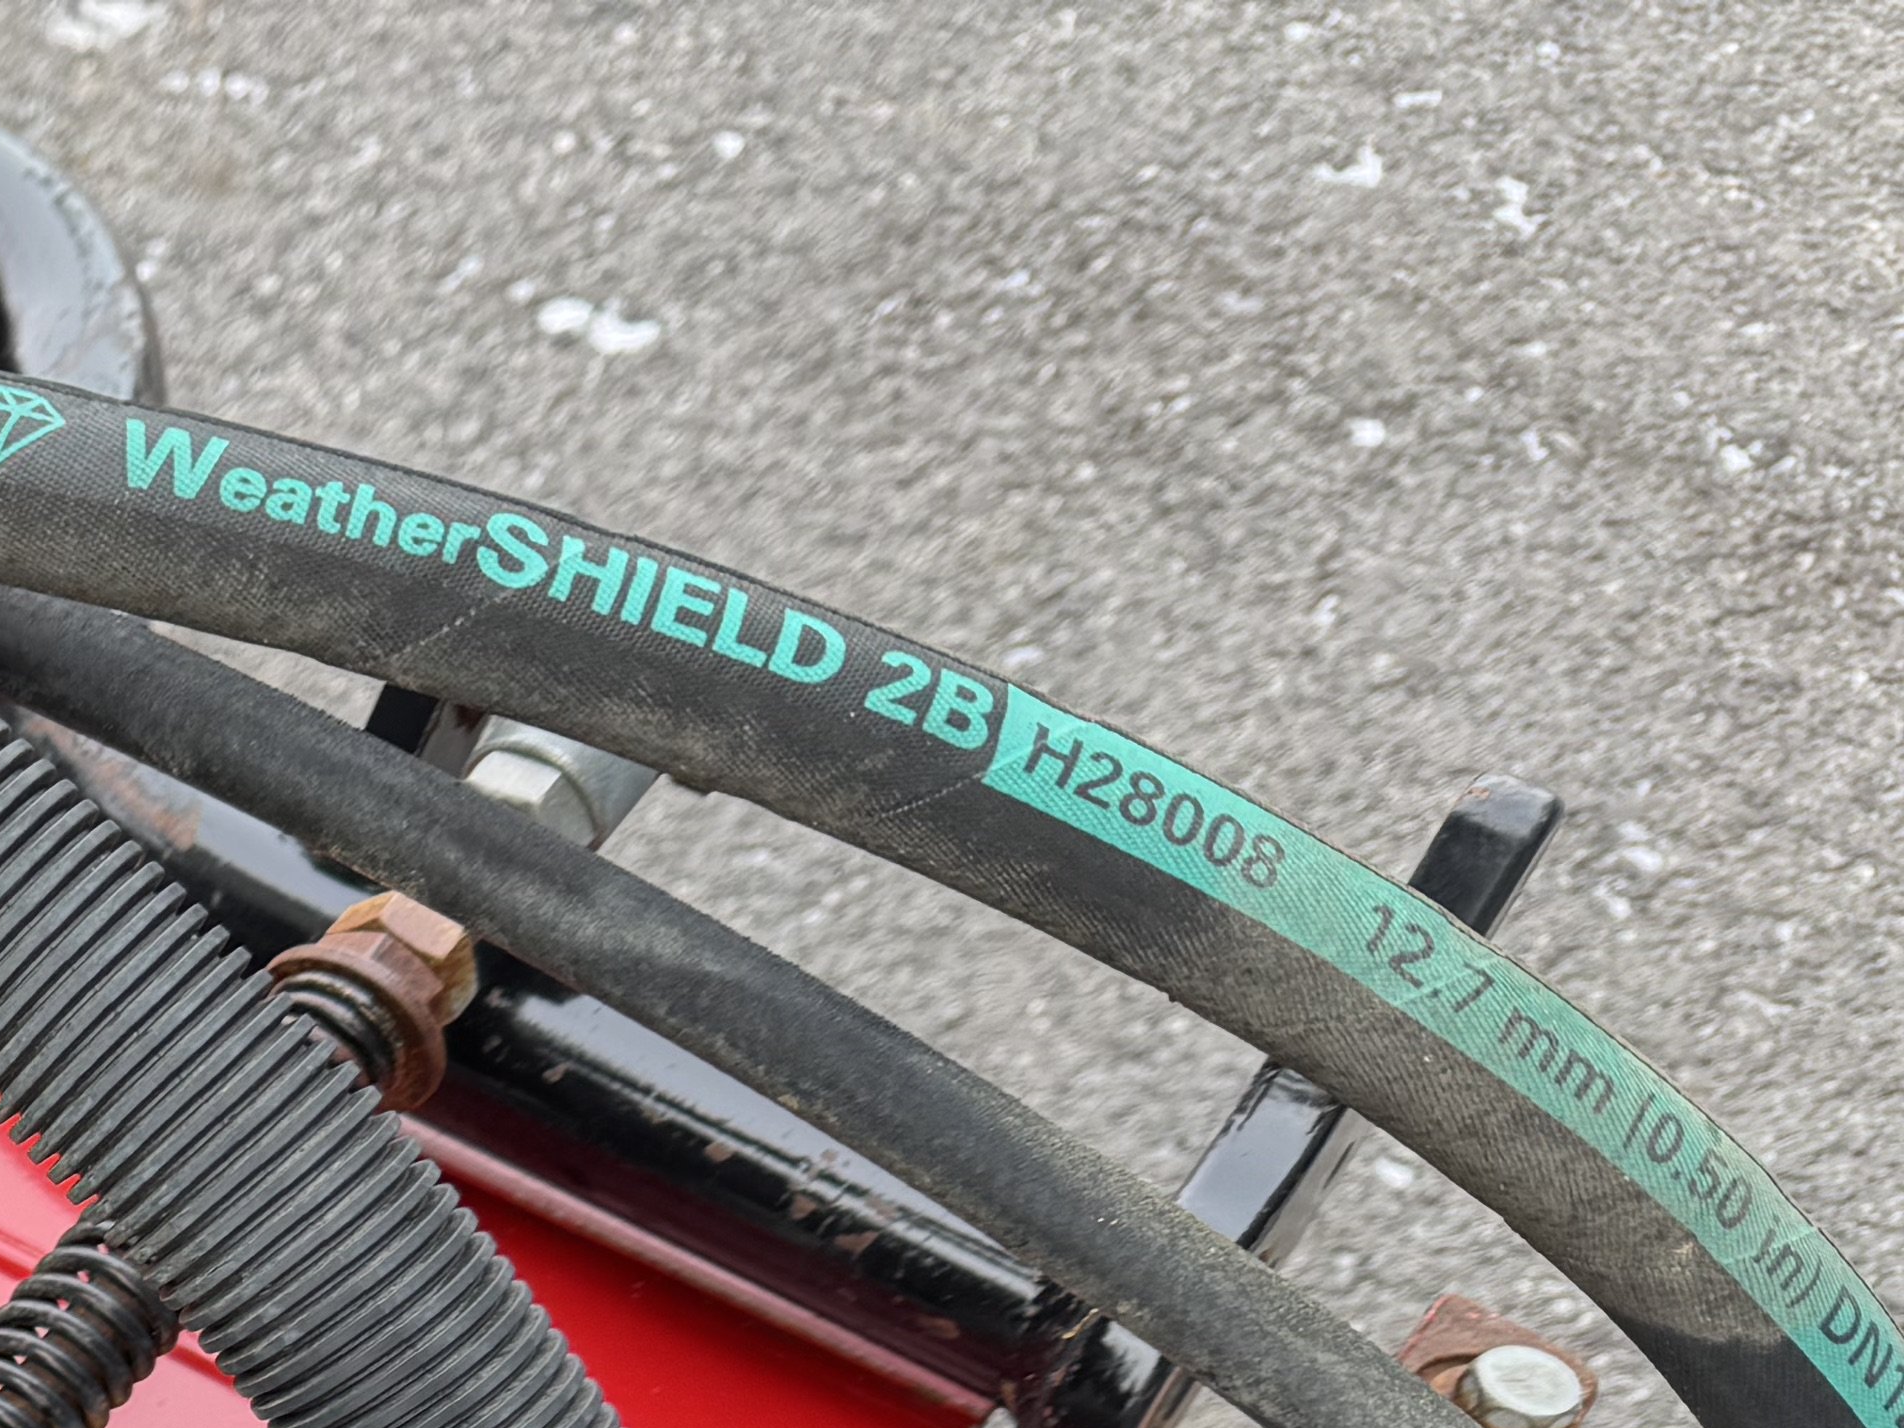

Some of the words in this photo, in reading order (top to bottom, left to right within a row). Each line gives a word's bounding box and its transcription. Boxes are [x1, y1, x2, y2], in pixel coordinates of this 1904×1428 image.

[124, 417, 847, 686] WeatherSHIELD
[864, 649, 996, 752] 2B
[1022, 722, 1288, 890] H28008
[1497, 1004, 1615, 1115] mm
[1751, 1222, 1824, 1309] in)
